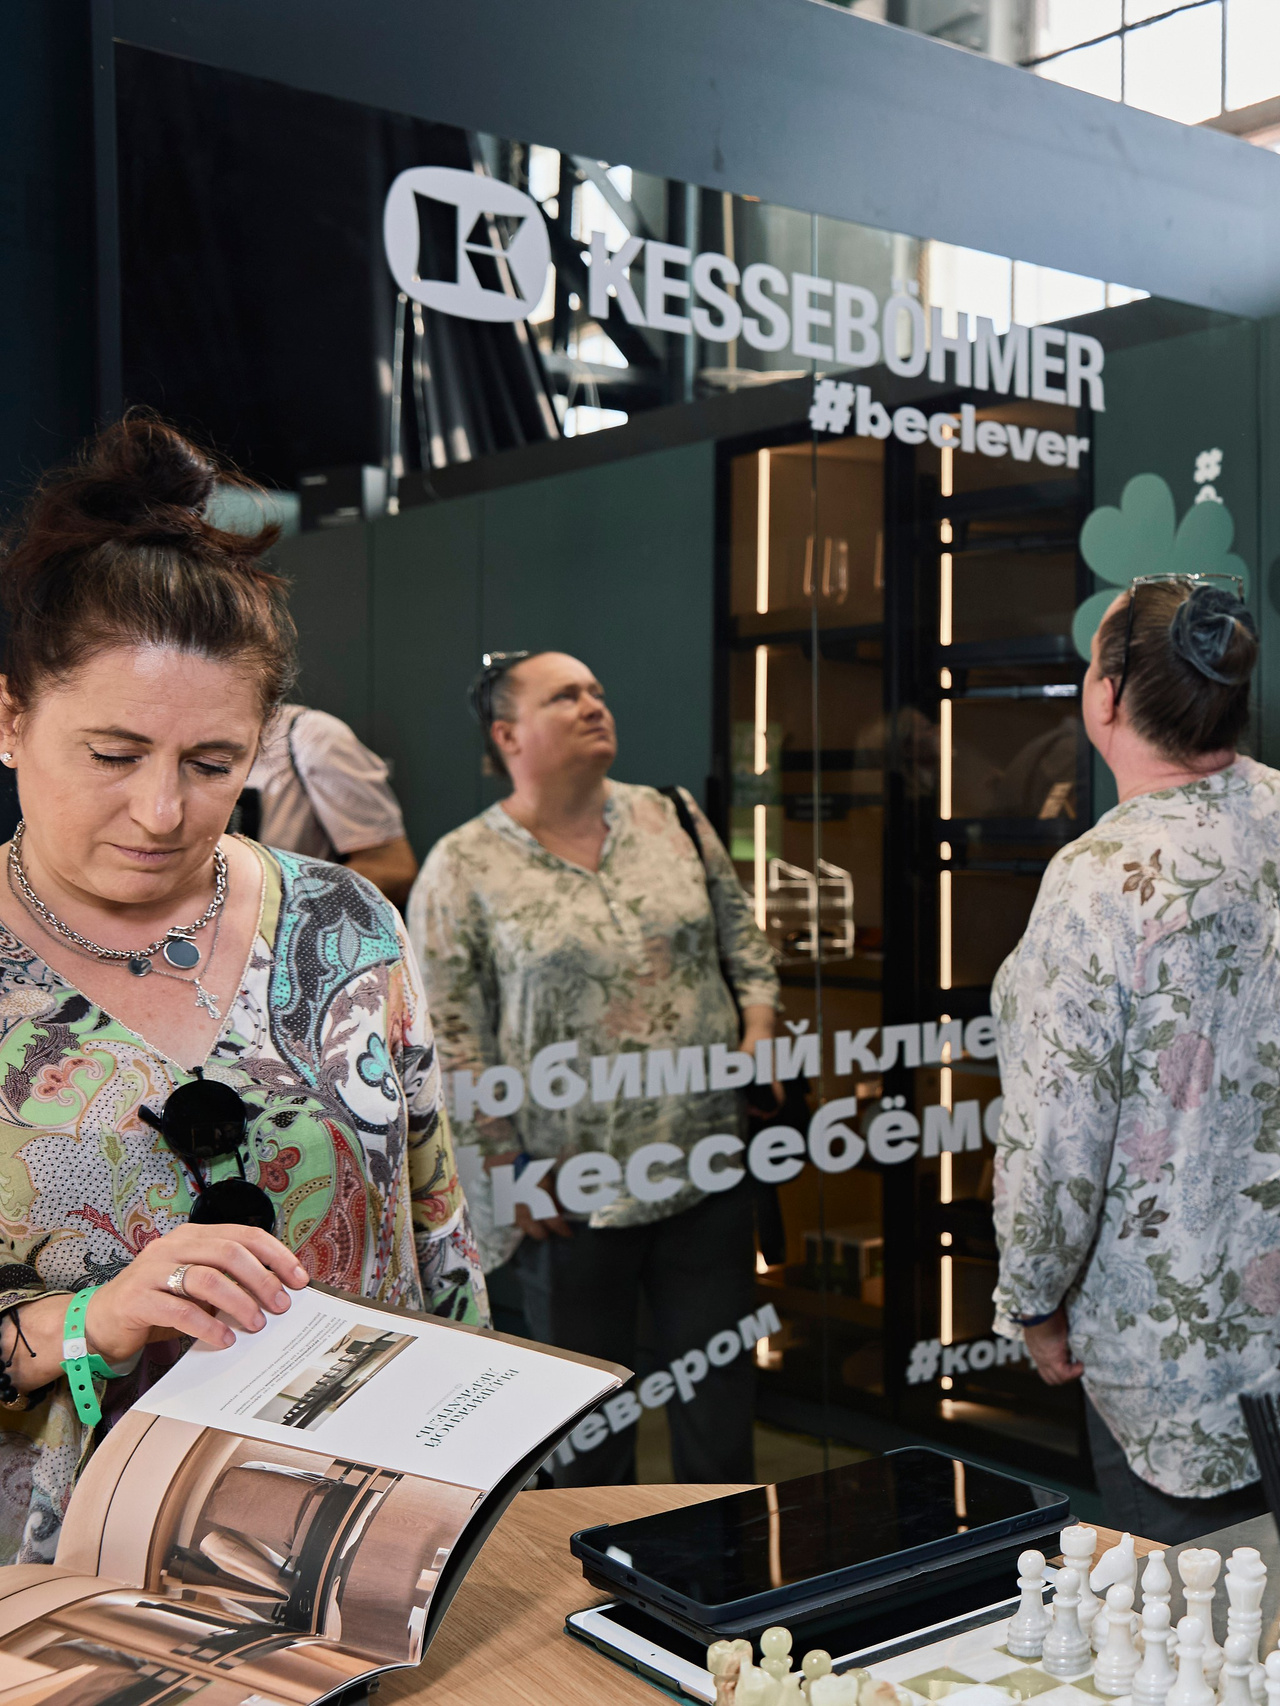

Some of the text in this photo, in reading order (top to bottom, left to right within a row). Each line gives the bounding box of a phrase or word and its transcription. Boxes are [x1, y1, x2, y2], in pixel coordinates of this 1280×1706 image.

[588, 230, 1106, 413] KESSEBÖHMER
[808, 377, 1090, 470] #beclever
[442, 1019, 821, 1122] юбимый
[456, 1093, 1004, 1227] кессебём
[415, 1366, 498, 1440] ДЕРЖАТЕЛЬ
[424, 1368, 520, 1449] ВЫДВИЖНОЙ
